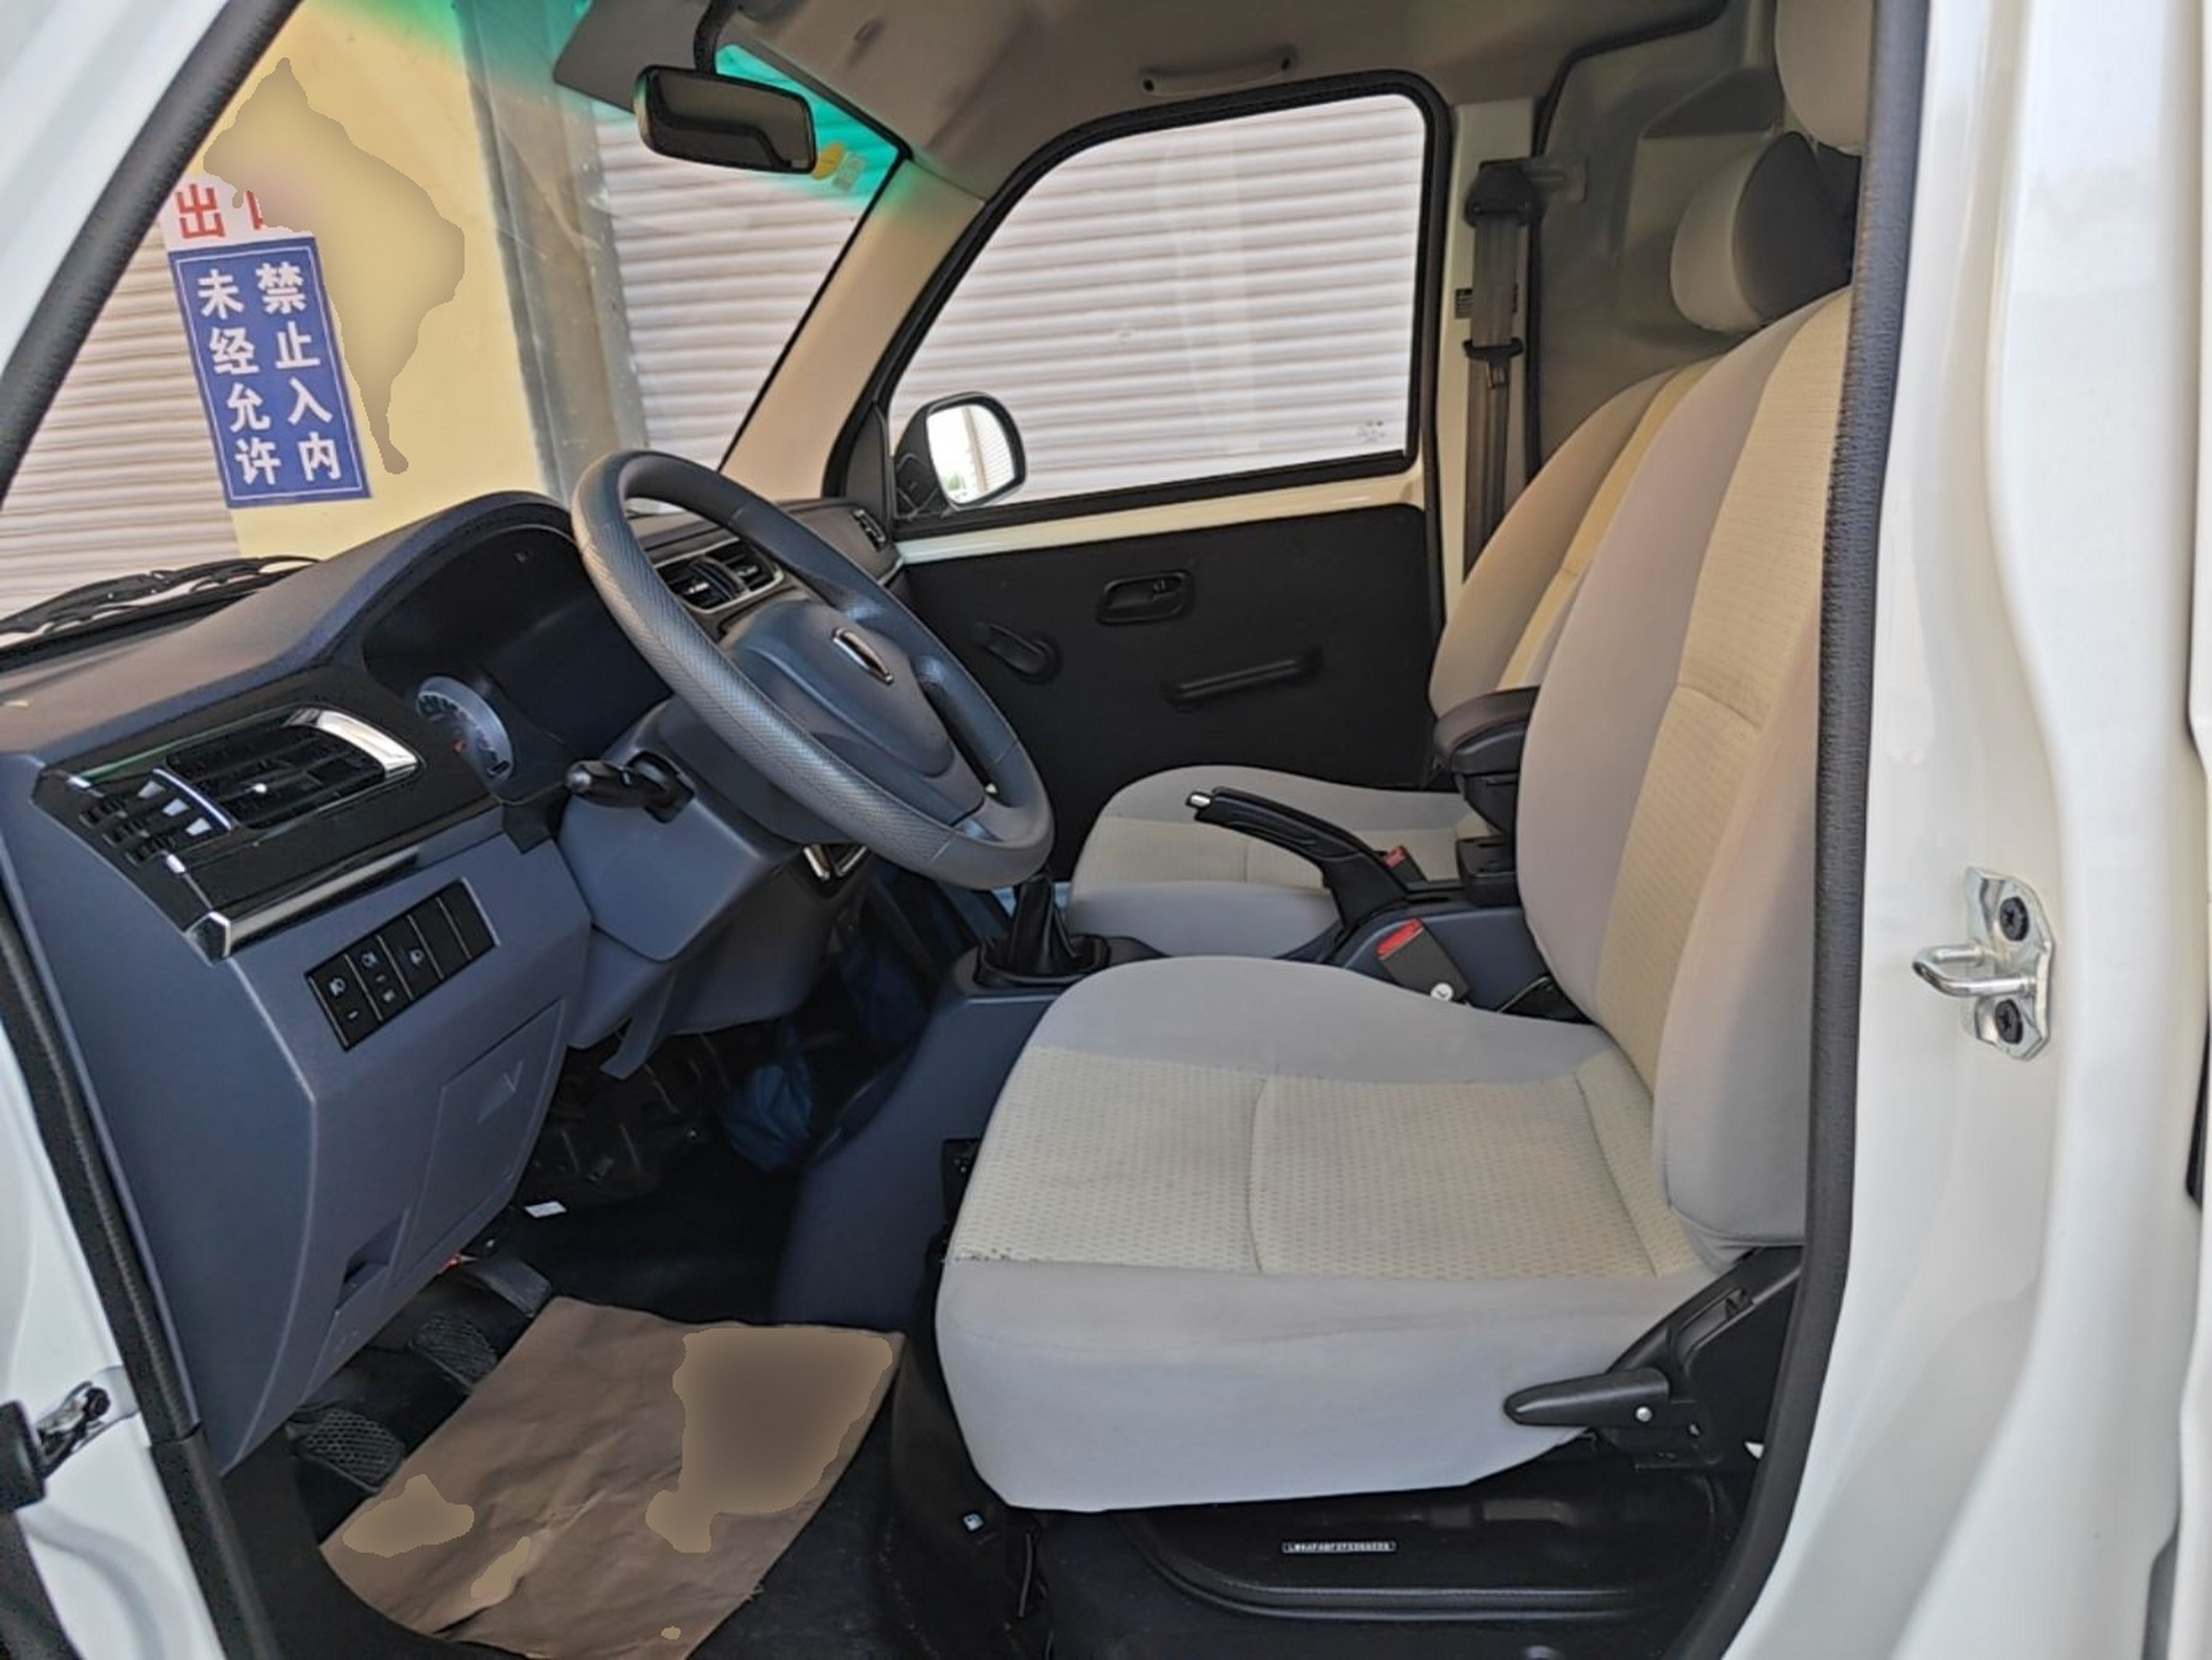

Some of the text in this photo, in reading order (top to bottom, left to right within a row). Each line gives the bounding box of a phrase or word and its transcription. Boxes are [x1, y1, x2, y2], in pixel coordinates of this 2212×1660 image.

[175, 183, 264, 239] 出
[197, 269, 282, 485] 未经允许
[255, 261, 343, 482] 禁止入内
